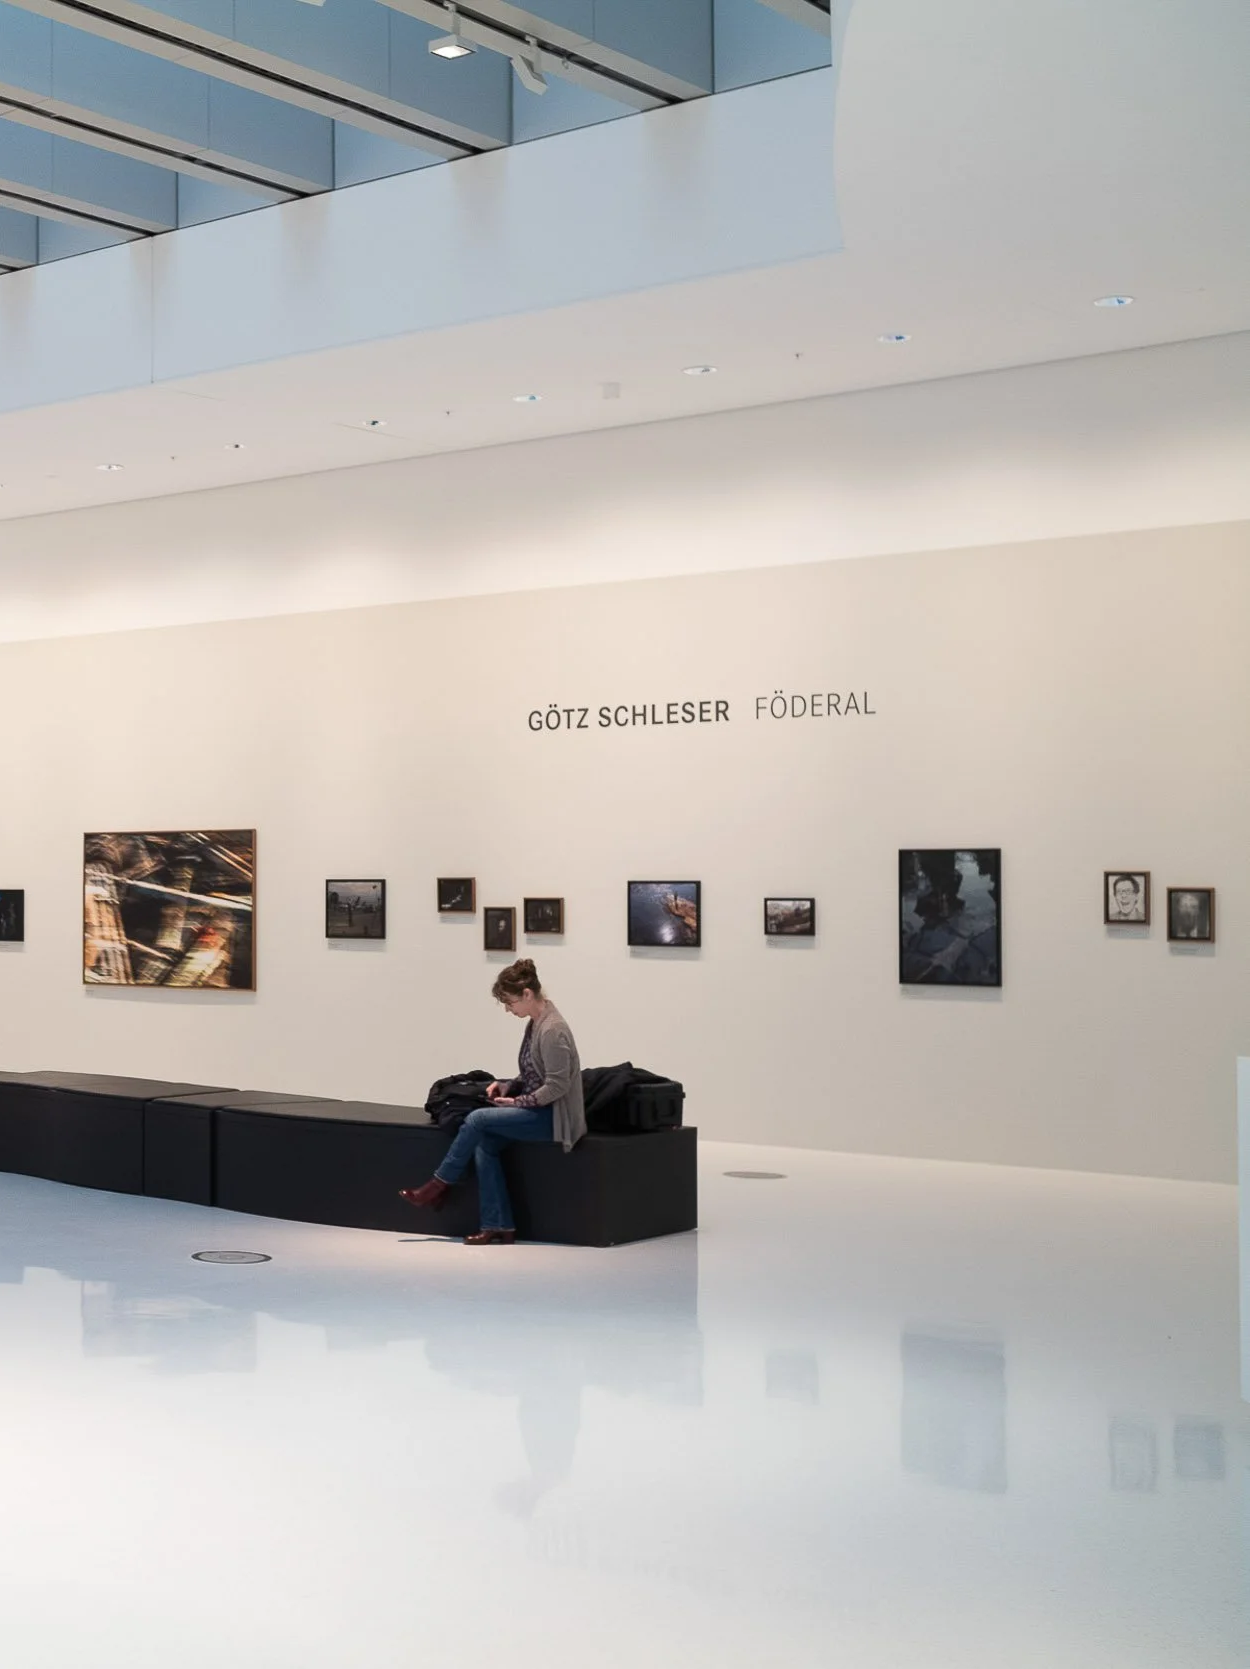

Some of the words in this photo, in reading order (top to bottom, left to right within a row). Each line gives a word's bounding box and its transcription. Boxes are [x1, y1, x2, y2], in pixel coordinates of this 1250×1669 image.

[528, 703, 590, 731] GÖTZ
[598, 700, 730, 727] SCHLESER
[755, 690, 877, 720] FÖDERAL
